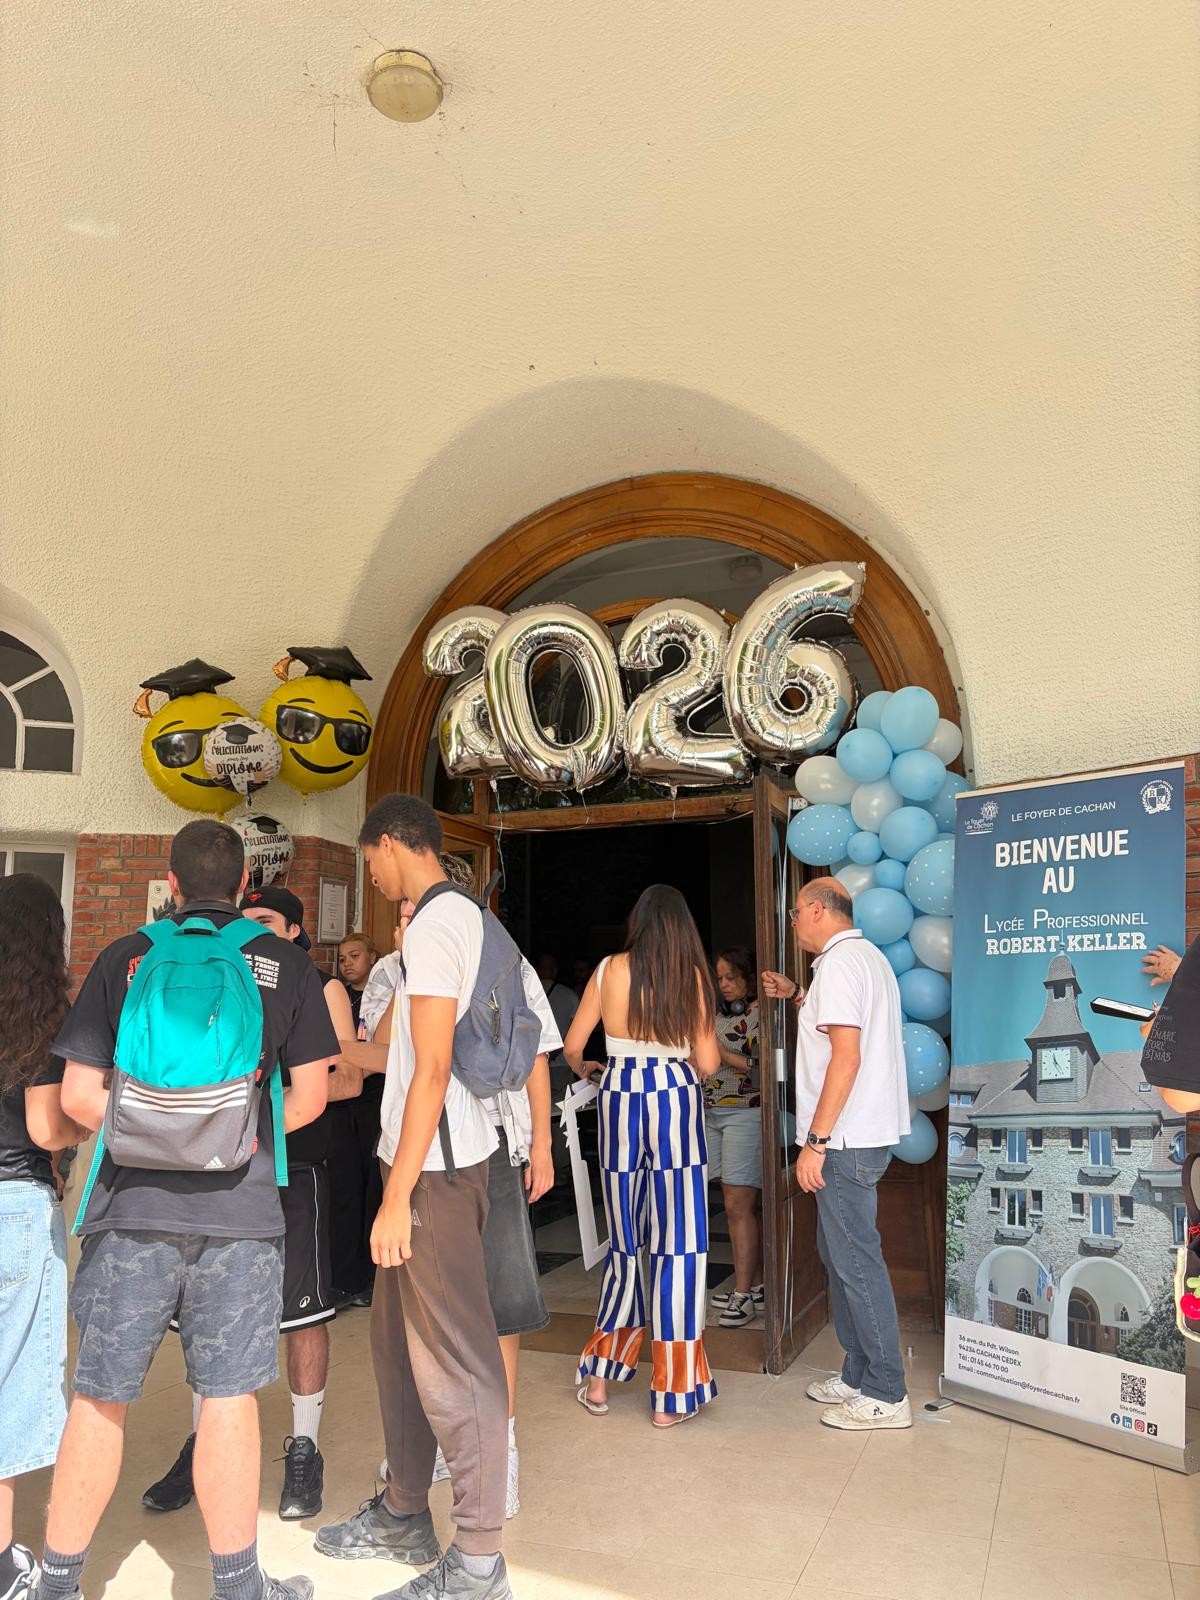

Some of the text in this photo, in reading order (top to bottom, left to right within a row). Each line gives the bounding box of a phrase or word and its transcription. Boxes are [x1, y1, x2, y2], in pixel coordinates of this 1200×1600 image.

[422, 561, 866, 791] 2026
[1012, 801, 1116, 822] LE FOYER DE CACHAN
[995, 829, 1129, 868] BIENVENUE
[1042, 866, 1075, 894] AU
[986, 932, 1147, 955] ROBERT KELLER
[976, 1349, 1001, 1361] CACHAN
[1001, 1355, 1022, 1367] CEDEX
[999, 1345, 1019, 1356] Wilson
[976, 1370, 1080, 1403] communication@foyerdecachan.fr
